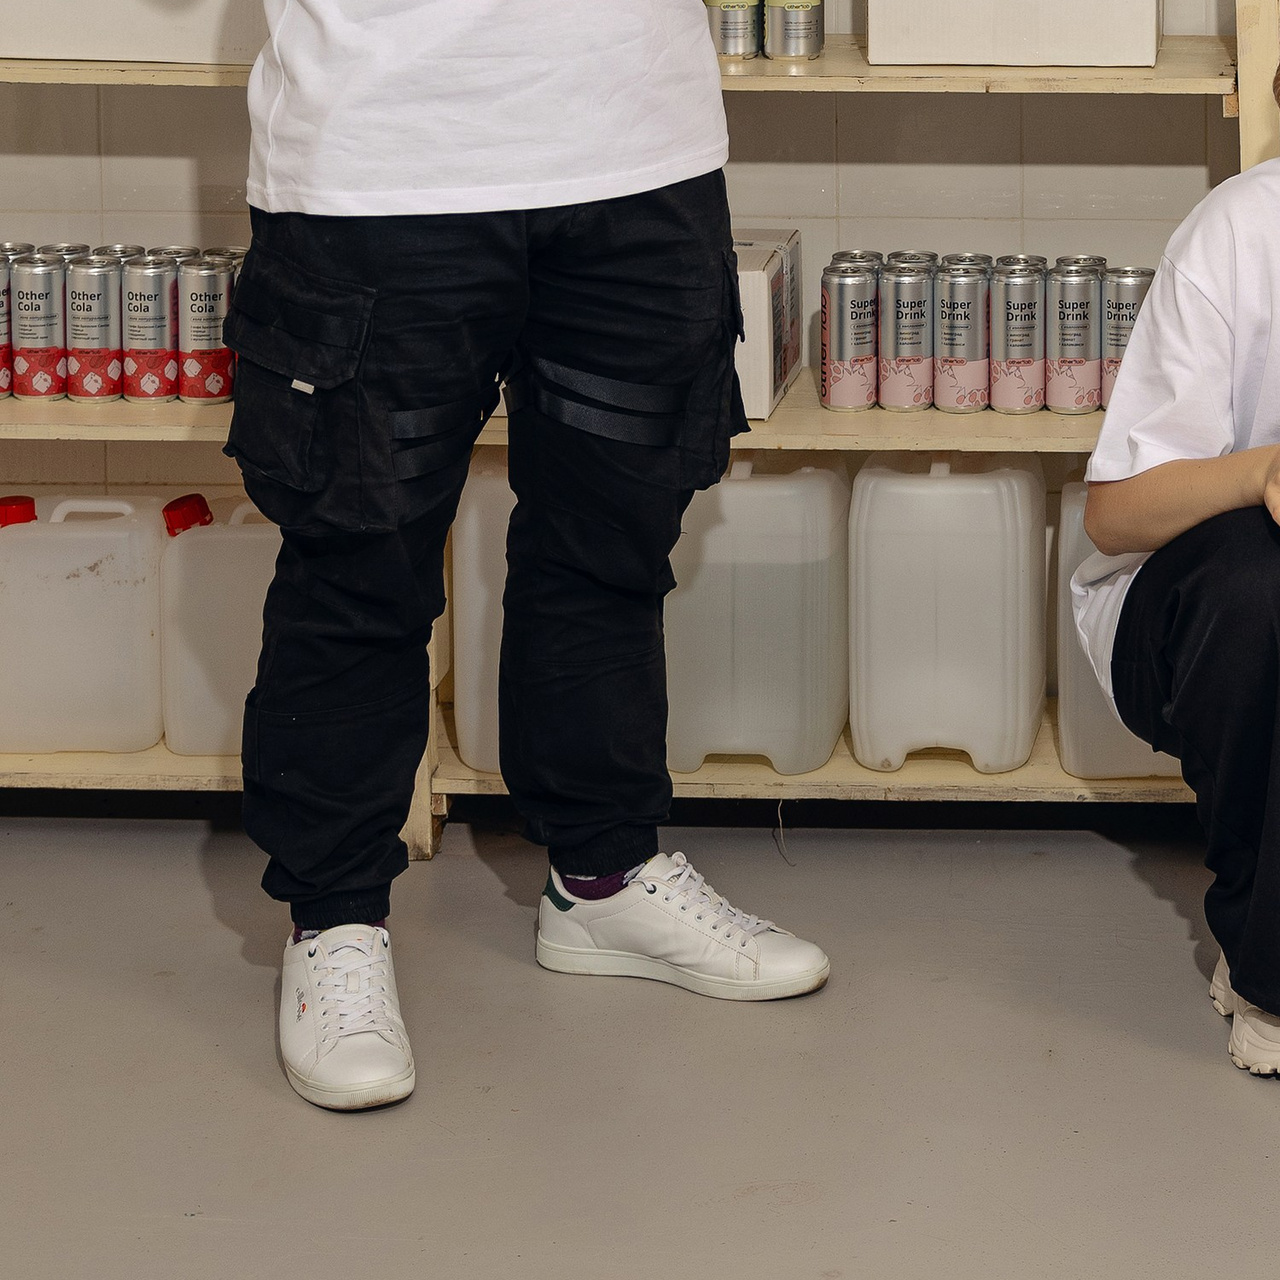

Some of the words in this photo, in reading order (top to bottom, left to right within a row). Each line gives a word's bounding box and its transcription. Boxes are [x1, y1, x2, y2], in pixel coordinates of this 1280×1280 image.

[17, 291, 50, 301] Other
[71, 291, 102, 301] Other
[128, 291, 159, 302] Other
[190, 292, 223, 302] Other
[18, 302, 41, 312] Cola
[71, 302, 92, 312] Cola
[128, 303, 149, 313] Cola
[190, 303, 215, 313] Cola
[896, 299, 927, 310] Super
[941, 299, 972, 310] Super
[1006, 300, 1037, 312] Super
[1058, 300, 1090, 311] Super
[1107, 300, 1137, 311] Super
[896, 310, 926, 320] Drink
[941, 310, 970, 321] Drink
[1007, 312, 1037, 321] Drink
[1058, 311, 1089, 320] Drink
[1107, 311, 1136, 321] Drink
